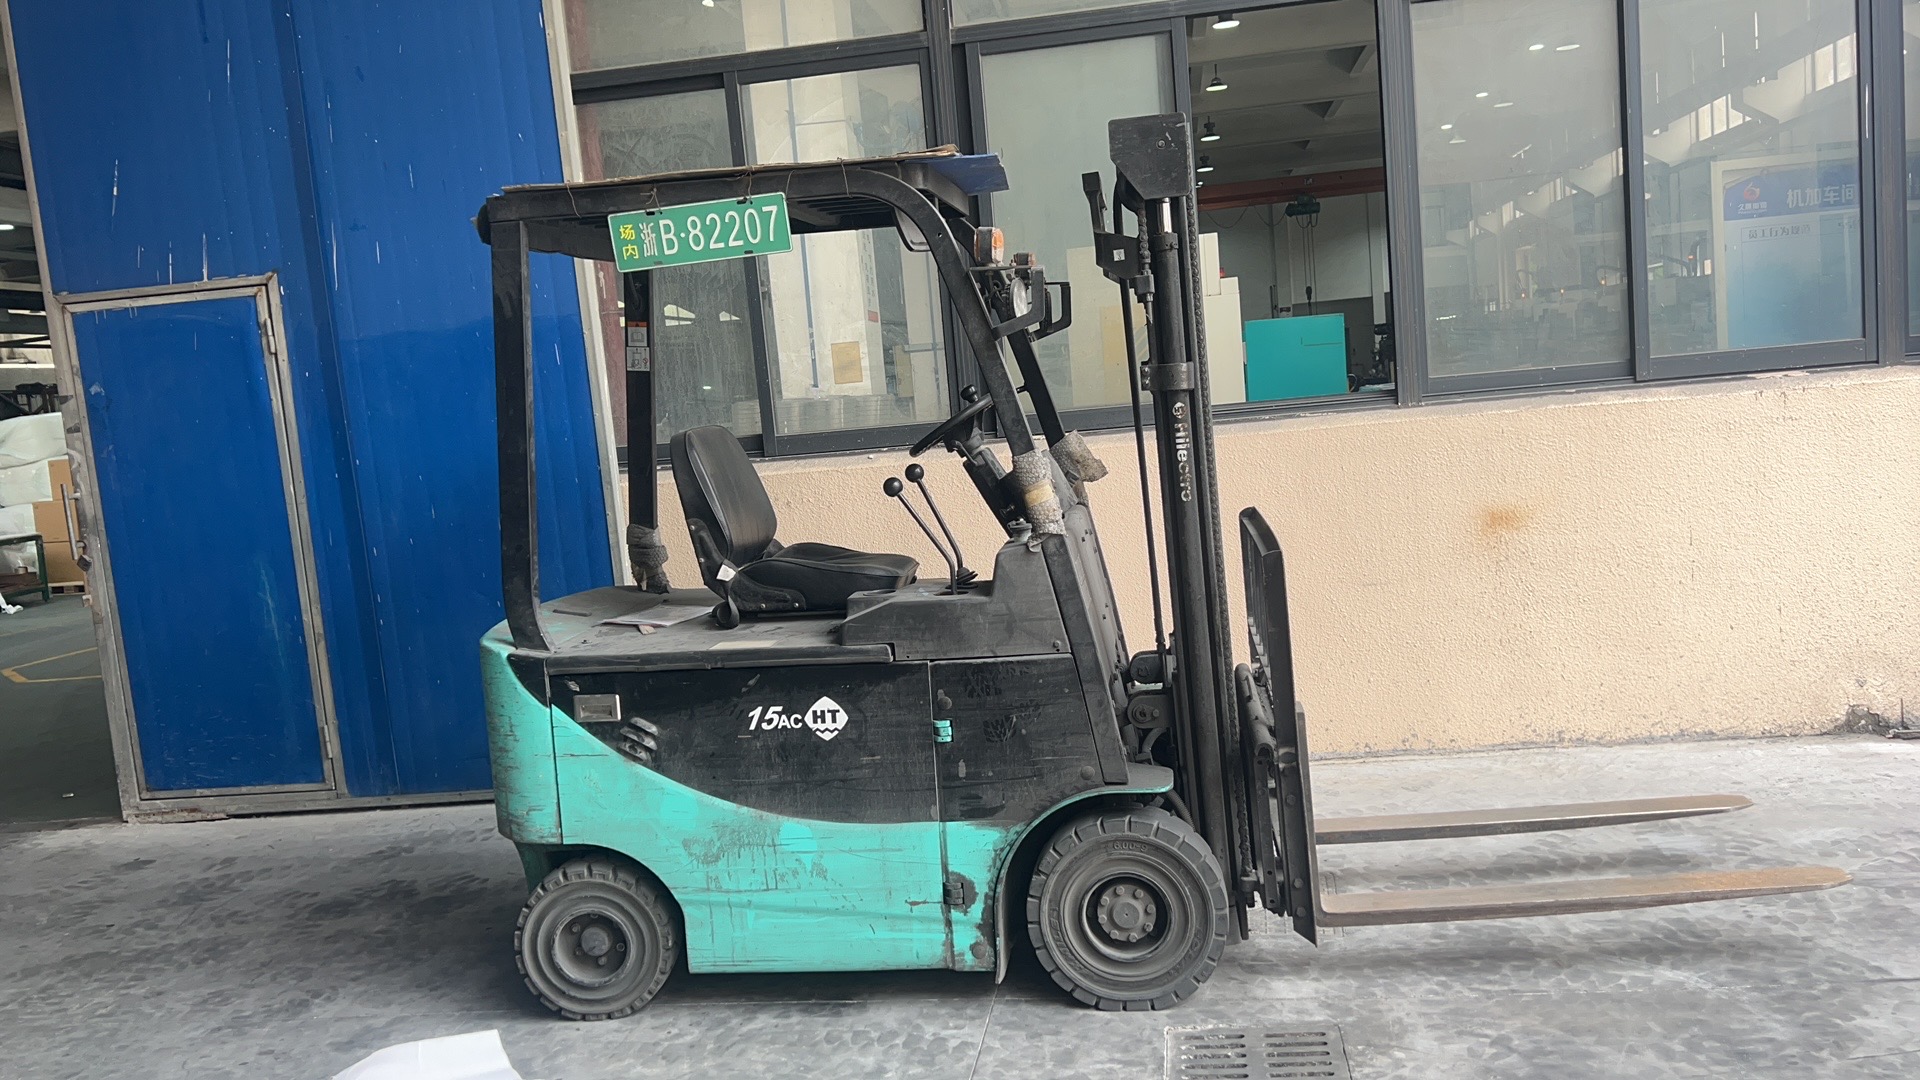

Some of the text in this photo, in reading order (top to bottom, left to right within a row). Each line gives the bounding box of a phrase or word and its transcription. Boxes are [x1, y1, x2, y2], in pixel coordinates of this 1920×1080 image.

[1786, 184, 1856, 209] 机加车间
[619, 224, 640, 261] 场内
[811, 709, 841, 725] HT
[1113, 840, 1149, 853] 6.00-9
